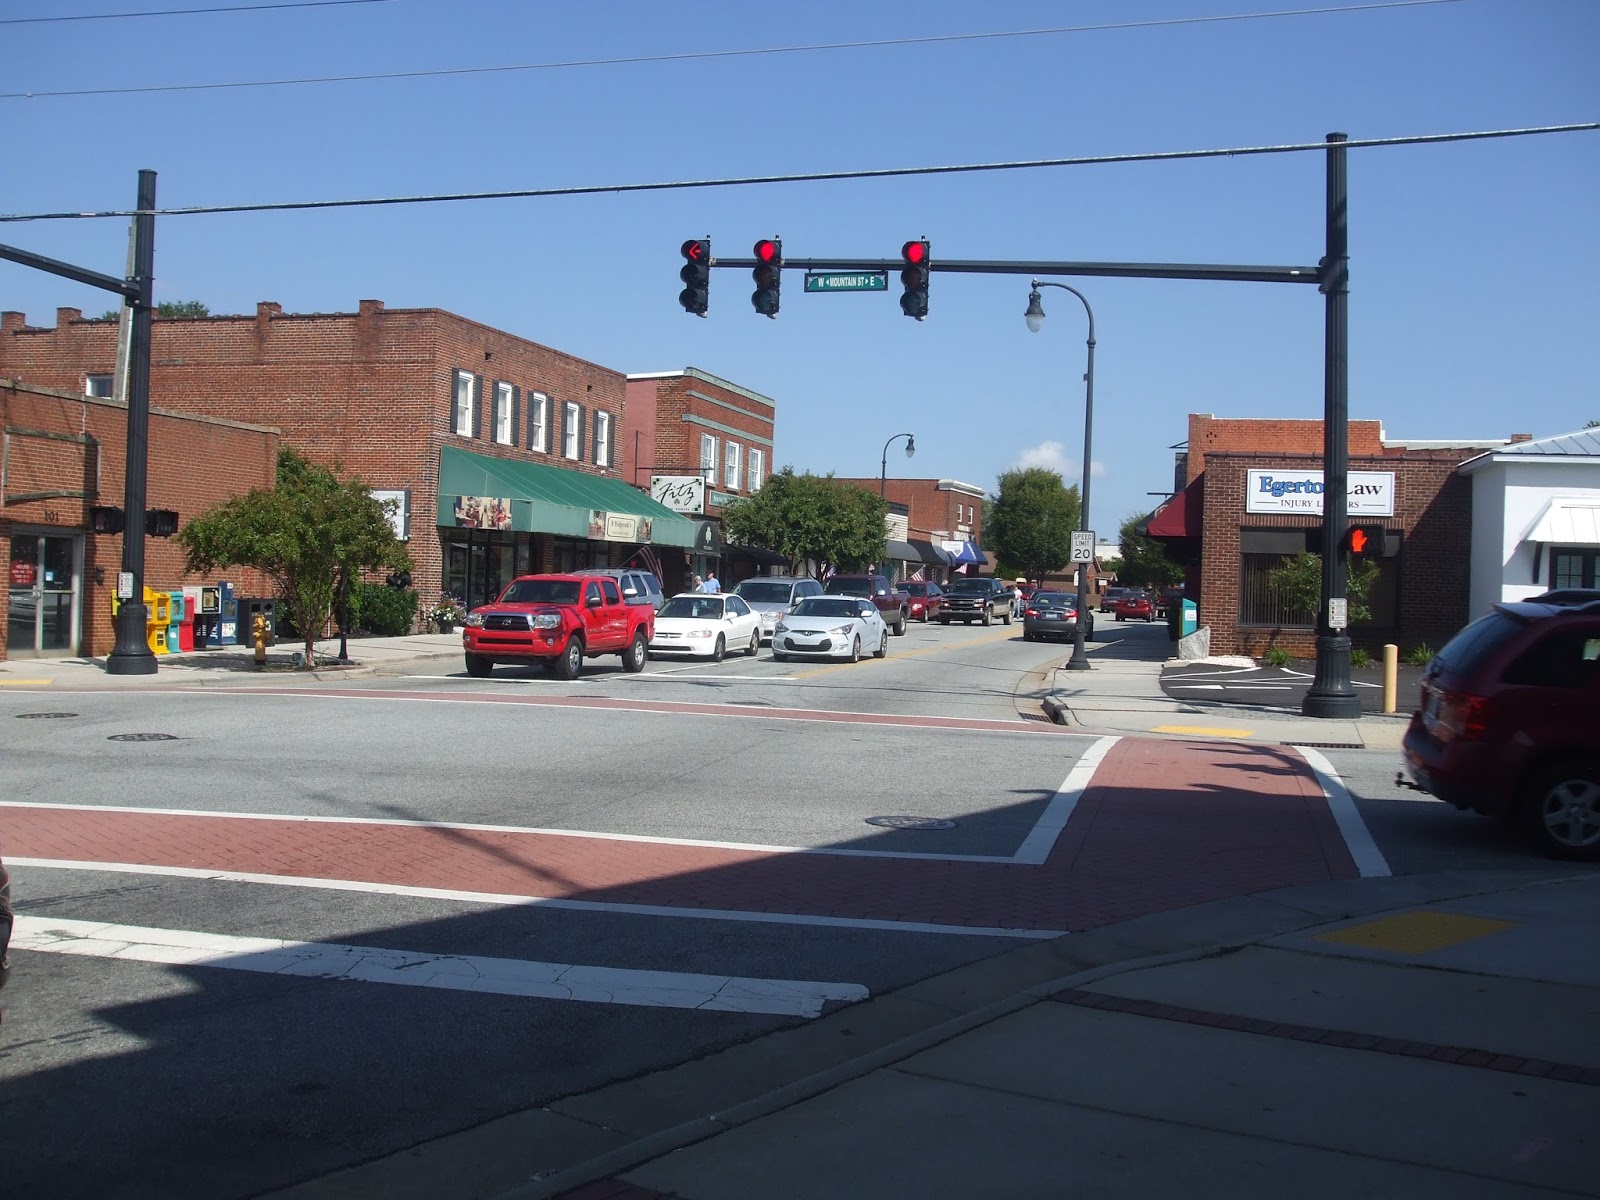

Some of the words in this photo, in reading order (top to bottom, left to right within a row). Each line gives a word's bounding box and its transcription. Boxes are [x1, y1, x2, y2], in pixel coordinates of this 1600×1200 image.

[818, 277, 825, 287] W
[829, 276, 857, 288] MOUNTAIN
[857, 276, 865, 287] ST
[870, 276, 875, 287] E
[1259, 476, 1325, 498] Egerto
[1346, 482, 1383, 496] aw
[656, 481, 699, 506] Fitz
[1280, 499, 1314, 508] INJURY
[44, 510, 59, 522] 101
[1073, 533, 1092, 541] SPEED
[1074, 548, 1091, 559] 20
